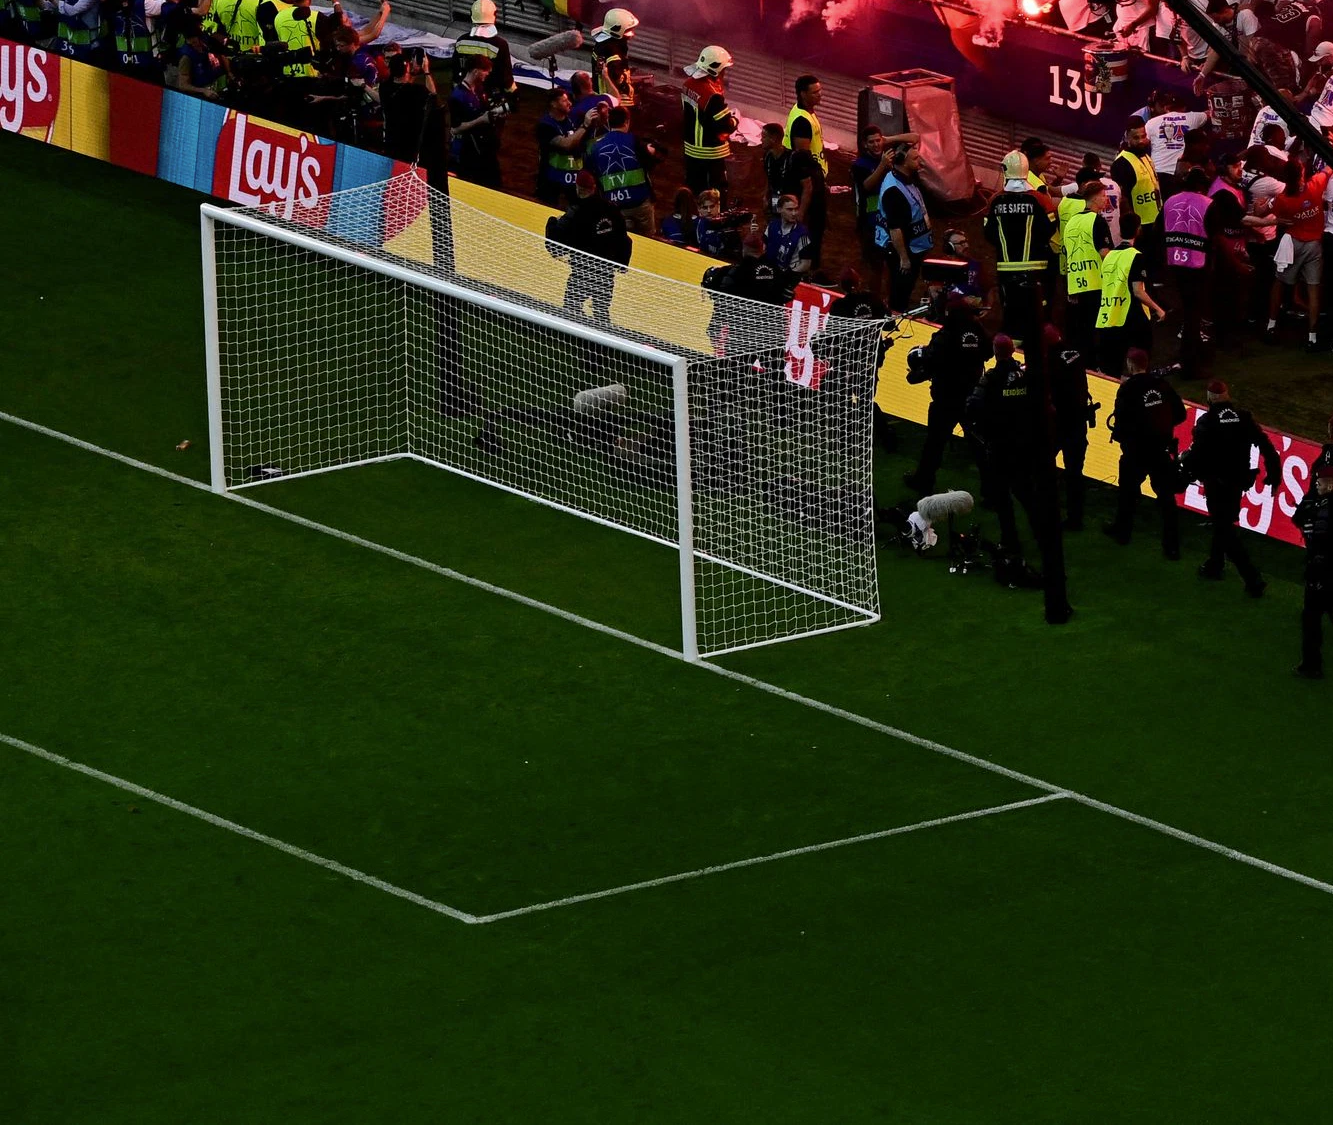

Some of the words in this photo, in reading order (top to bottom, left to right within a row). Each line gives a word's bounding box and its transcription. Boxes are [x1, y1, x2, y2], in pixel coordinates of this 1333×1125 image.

[1048, 64, 1102, 116] 130
[228, 113, 321, 221] Lay's
[608, 175, 626, 187] TV
[609, 189, 632, 203] 461
[1008, 203, 1034, 215] SAFETY
[1173, 249, 1189, 263] 63
[1076, 275, 1088, 288] 56
